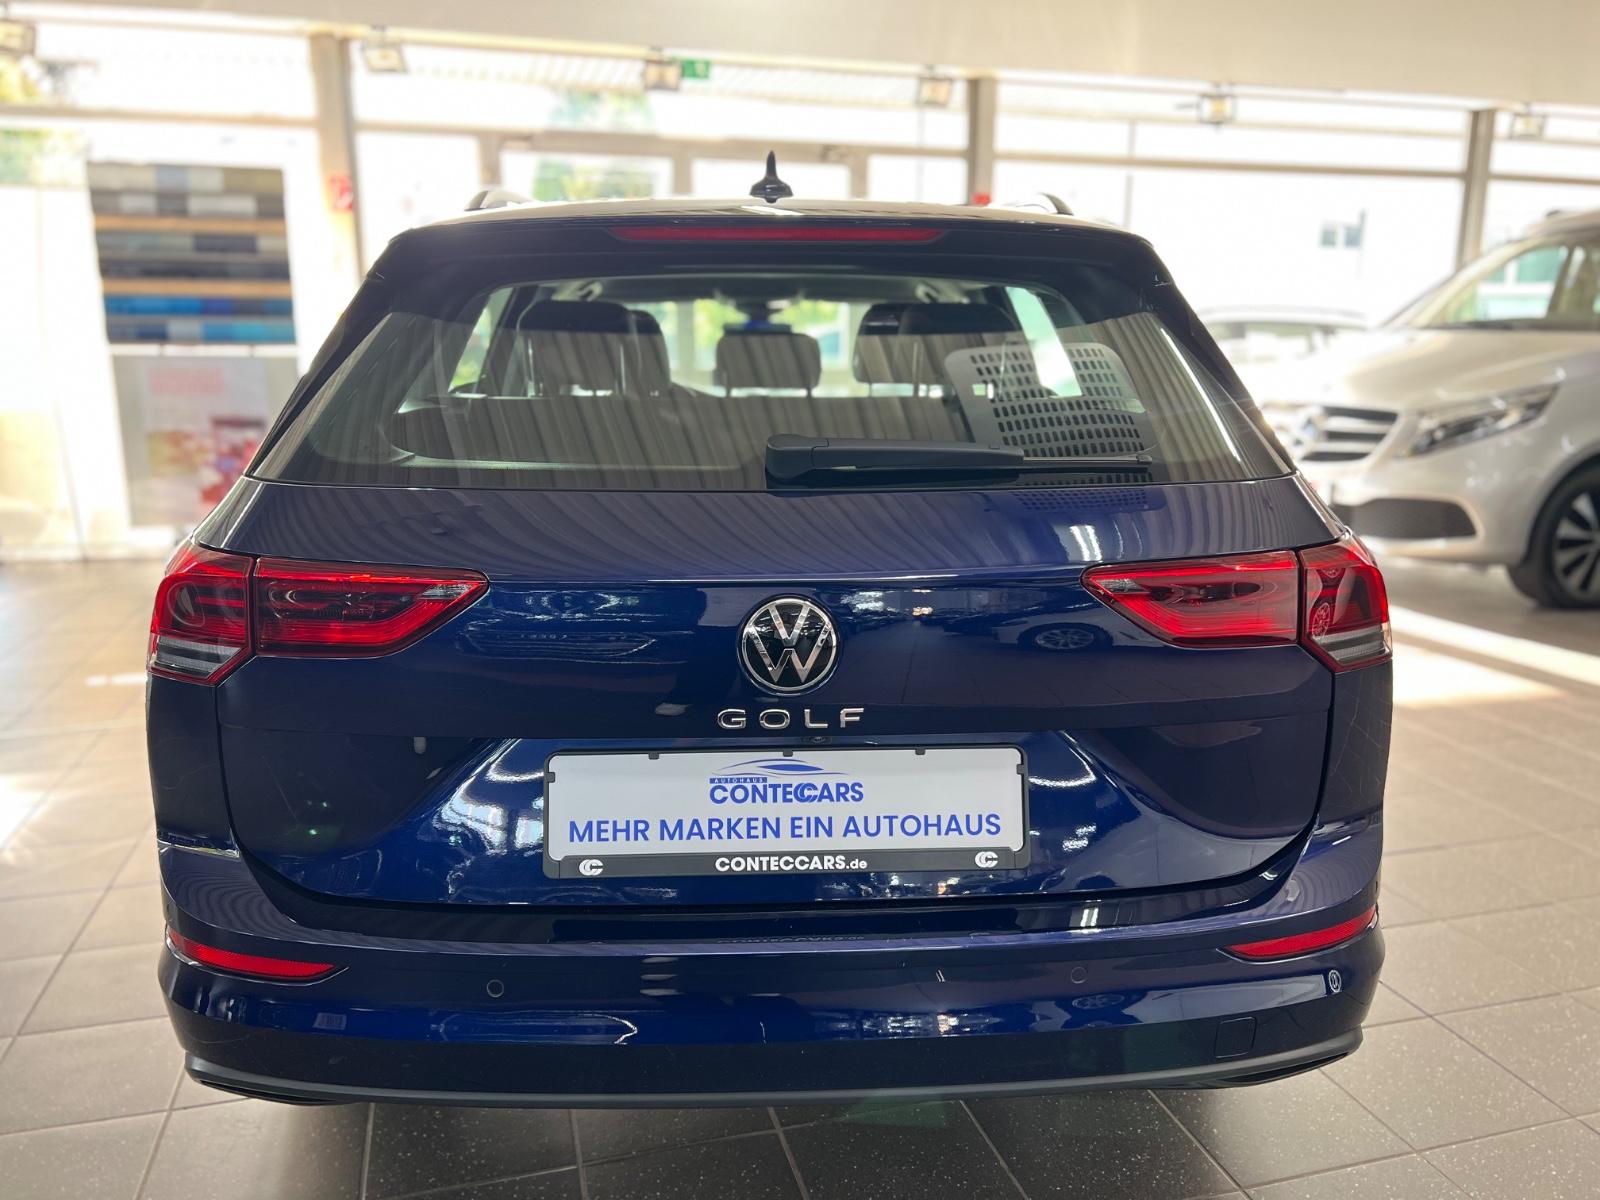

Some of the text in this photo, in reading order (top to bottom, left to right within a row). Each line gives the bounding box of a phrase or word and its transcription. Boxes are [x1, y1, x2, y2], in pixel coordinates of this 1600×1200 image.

[717, 707, 865, 730] GOLF
[709, 782, 864, 804] CONTECCARS
[568, 813, 1002, 843] MEHR MARKEN EIN AUTOHAUS
[715, 854, 868, 872] CONTECCARS.de
